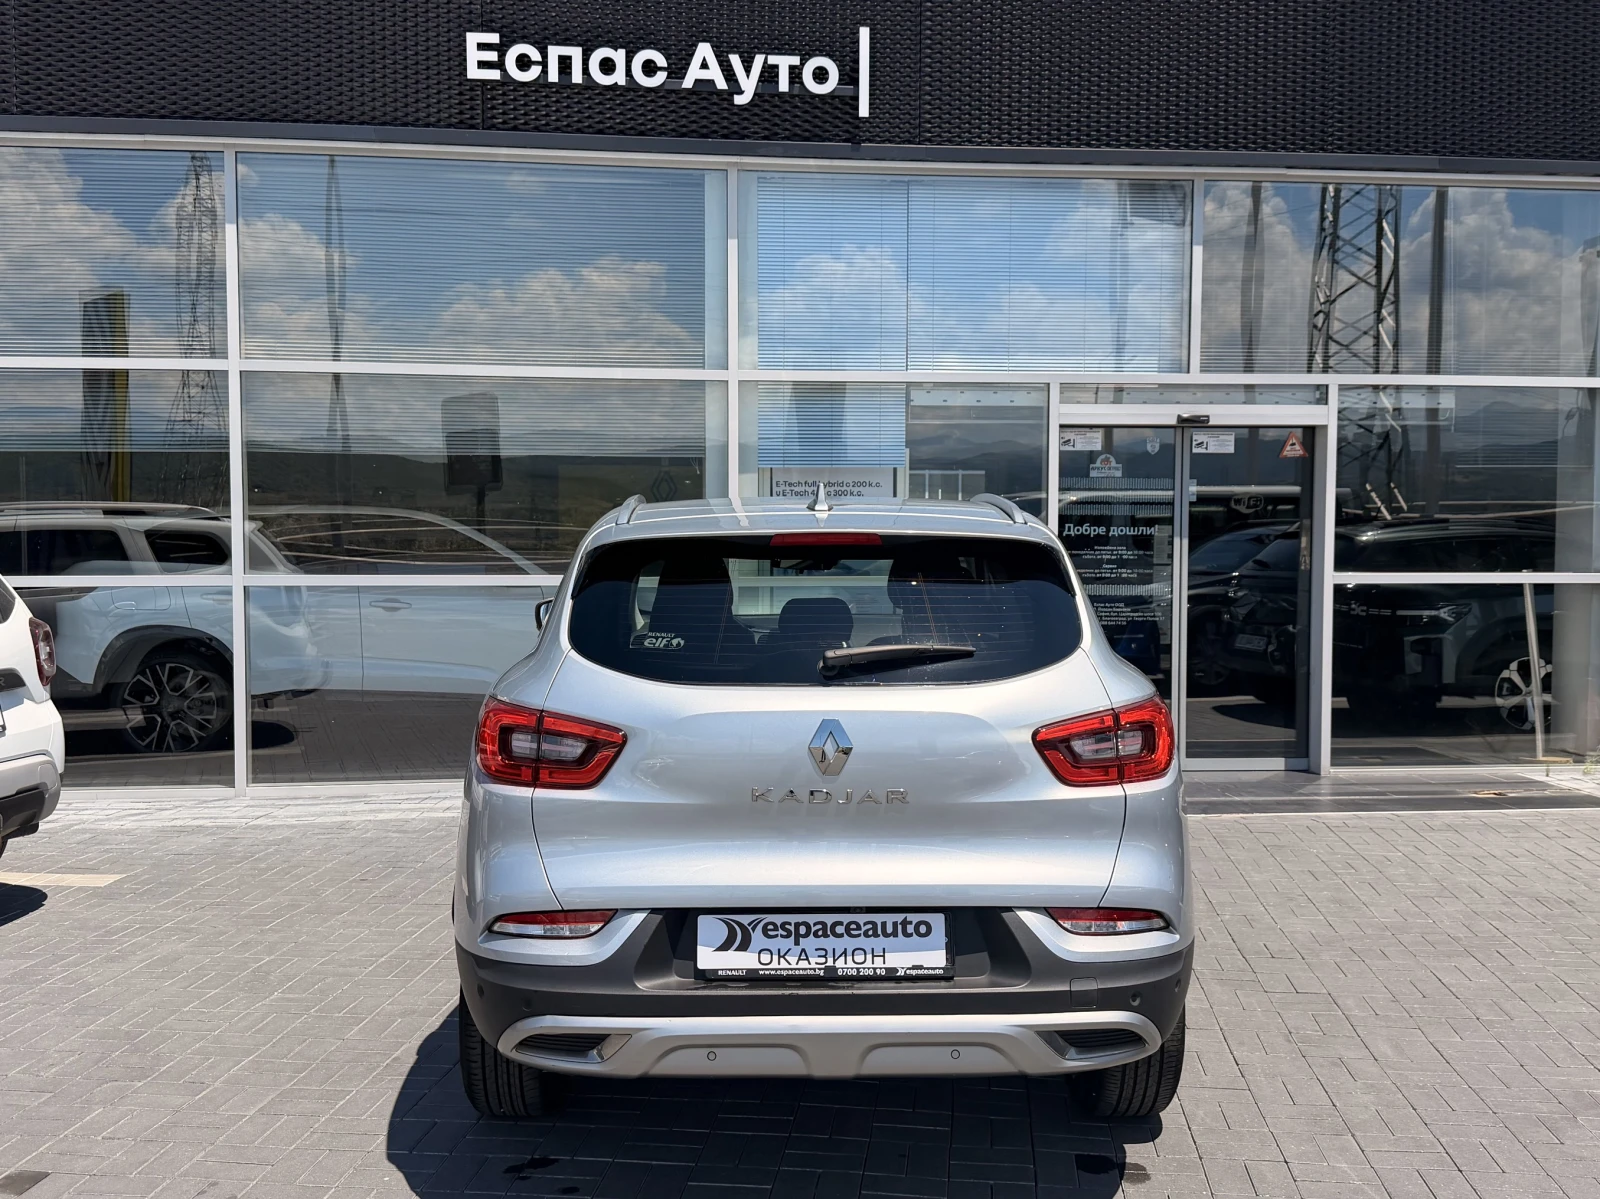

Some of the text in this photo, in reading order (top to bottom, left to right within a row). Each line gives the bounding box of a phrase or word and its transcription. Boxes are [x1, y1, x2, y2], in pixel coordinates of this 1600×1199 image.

[465, 31, 840, 106] Еспас Ауто
[775, 480, 804, 488] E-Tech
[804, 480, 817, 488] full
[851, 480, 868, 488] 200
[782, 489, 810, 497] E-Tech
[832, 489, 849, 497] 300
[1062, 523, 1159, 538] Добре дошли!
[643, 637, 670, 648] elf
[751, 786, 910, 805] KADJAR
[761, 916, 933, 946] espaceauto
[757, 947, 887, 967] ОКАЗИОН
[758, 968, 825, 978] www.espaceauto.bg
[837, 968, 857, 977] 0700
[859, 968, 873, 977] 200
[875, 968, 886, 977] 90
[906, 968, 944, 977] espaceauto
